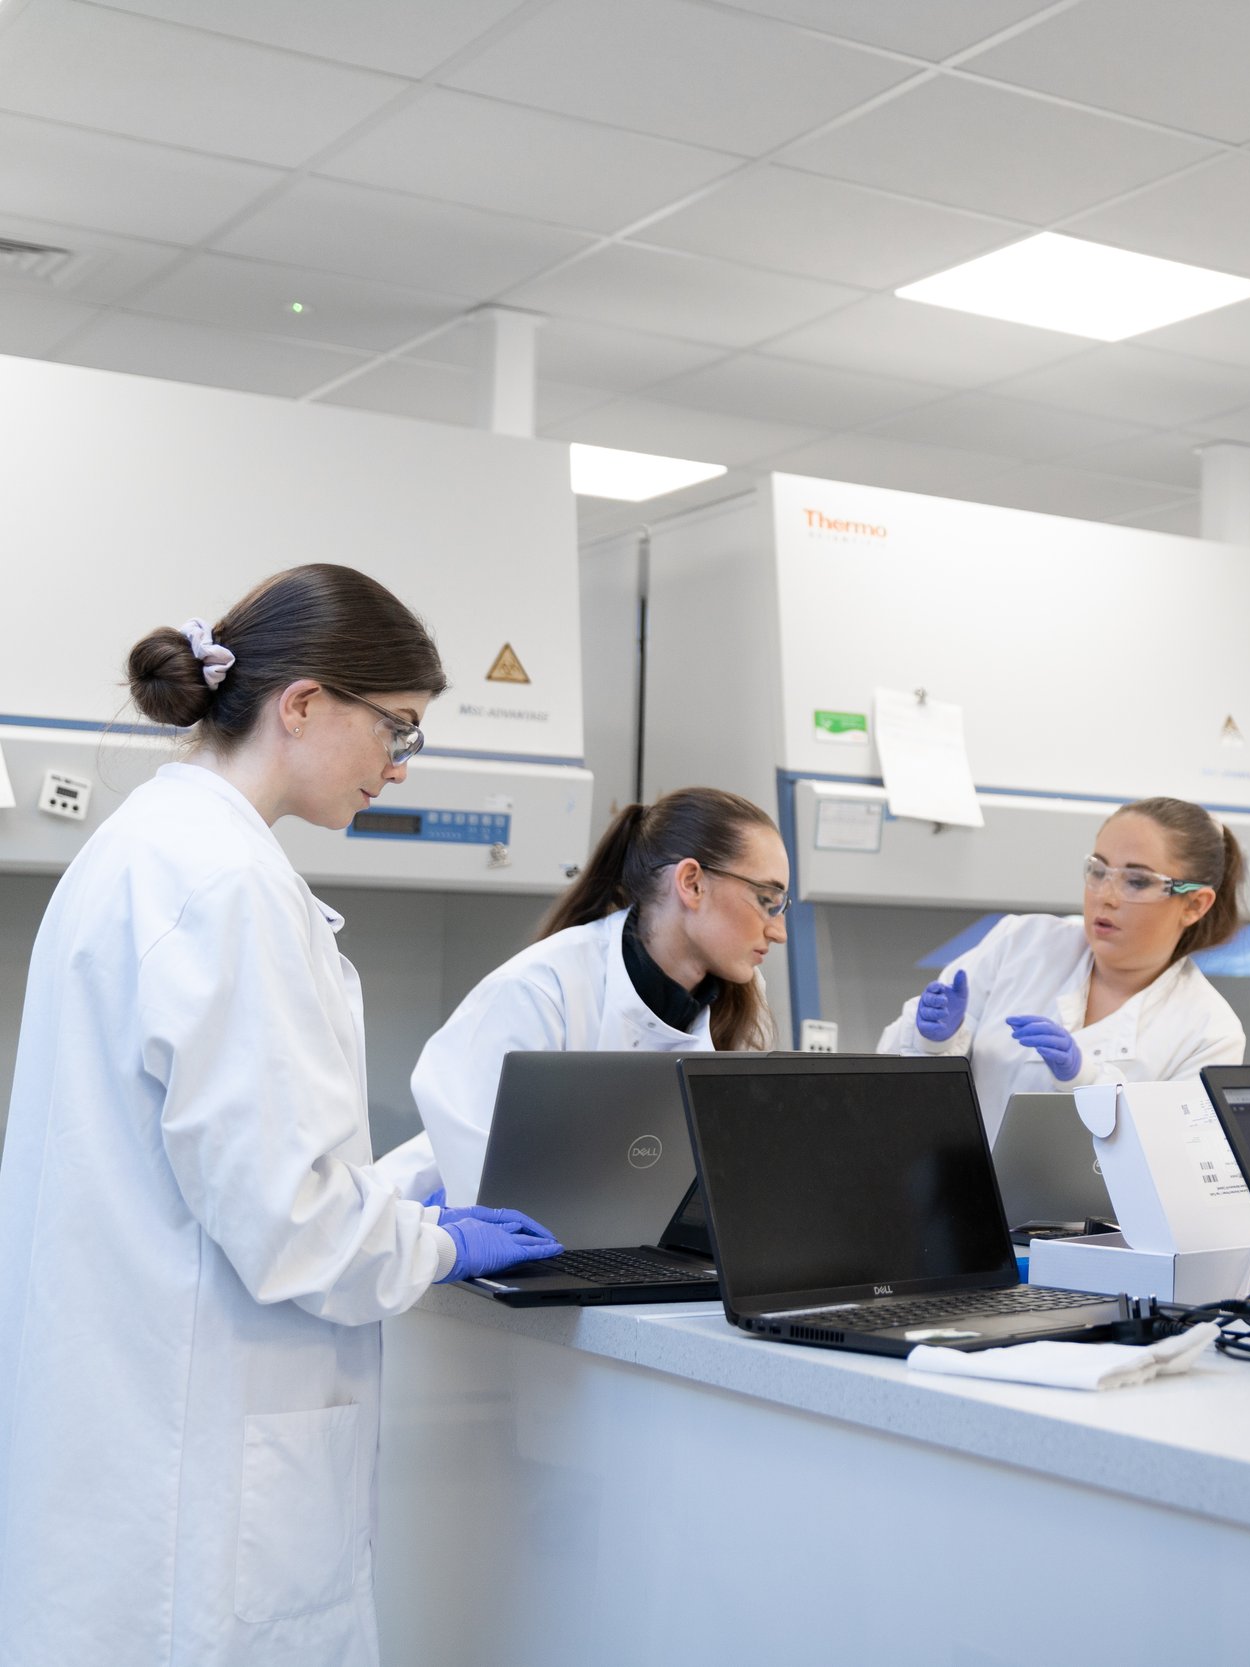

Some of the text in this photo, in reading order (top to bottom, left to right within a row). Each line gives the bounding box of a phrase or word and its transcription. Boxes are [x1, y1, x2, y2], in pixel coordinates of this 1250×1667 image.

[802, 508, 887, 538] Thermo
[632, 1147, 658, 1157] DELL
[873, 1285, 893, 1295] DELL
